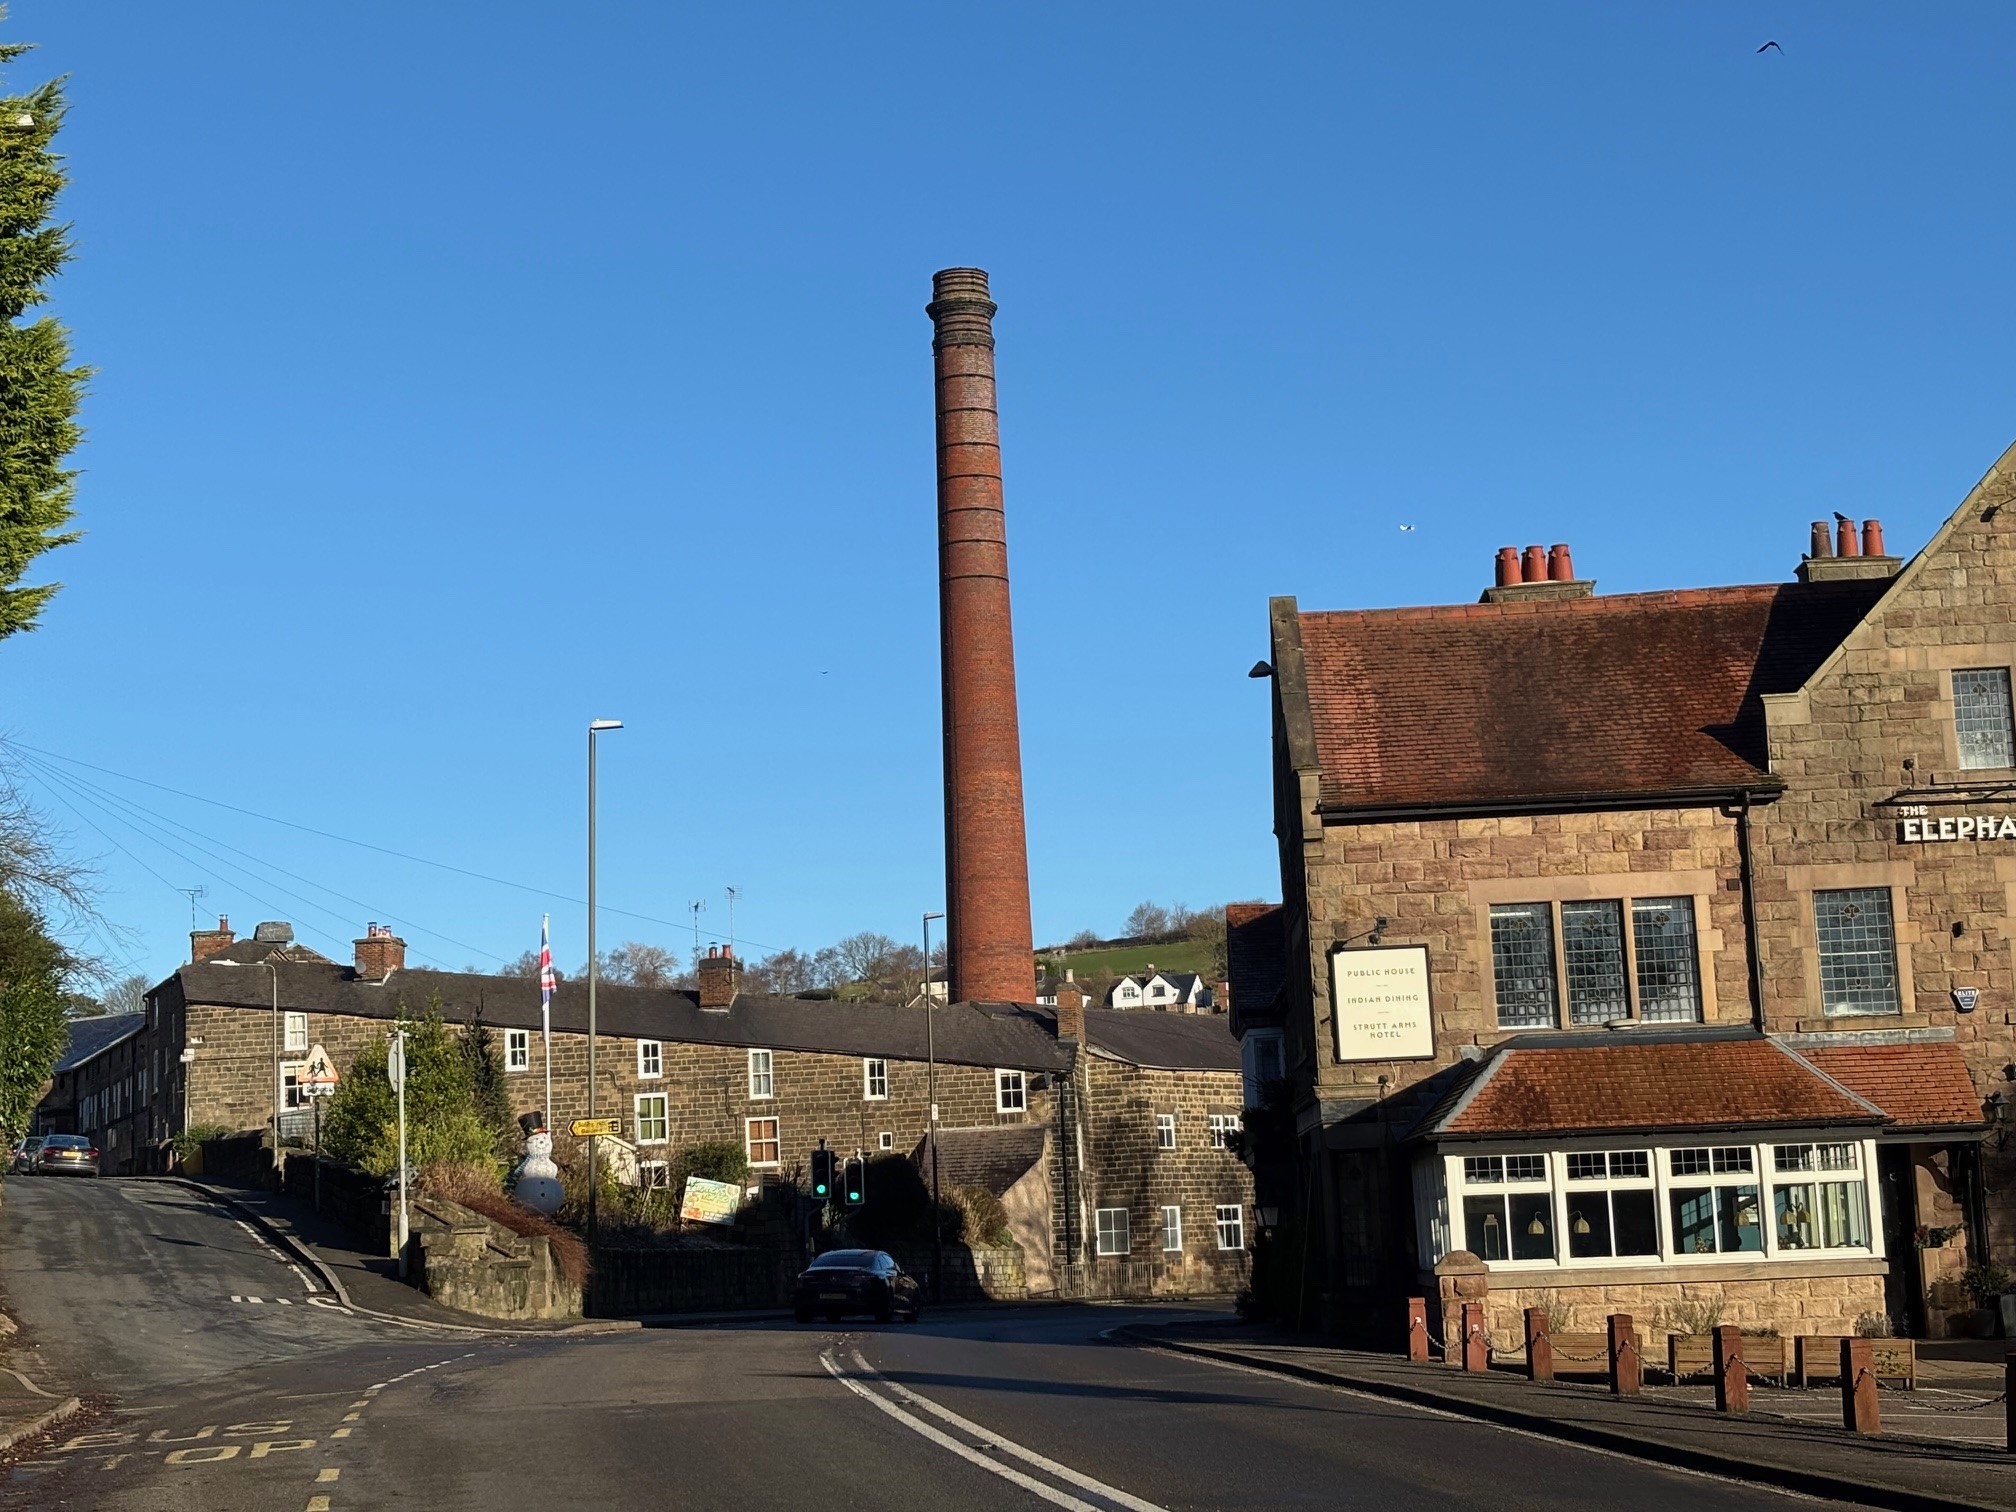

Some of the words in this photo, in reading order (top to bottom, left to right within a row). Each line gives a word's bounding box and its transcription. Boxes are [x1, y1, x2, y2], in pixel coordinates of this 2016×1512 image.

[1900, 805, 1928, 816] THE
[1903, 815, 2016, 842] ELEPHA
[1347, 969, 1380, 977] PUBLIC
[1347, 996, 1381, 1004] INDIAN
[1391, 1021, 1417, 1029] ARMS
[1370, 1031, 1401, 1039] HOTEL
[58, 1420, 294, 1450] BUS
